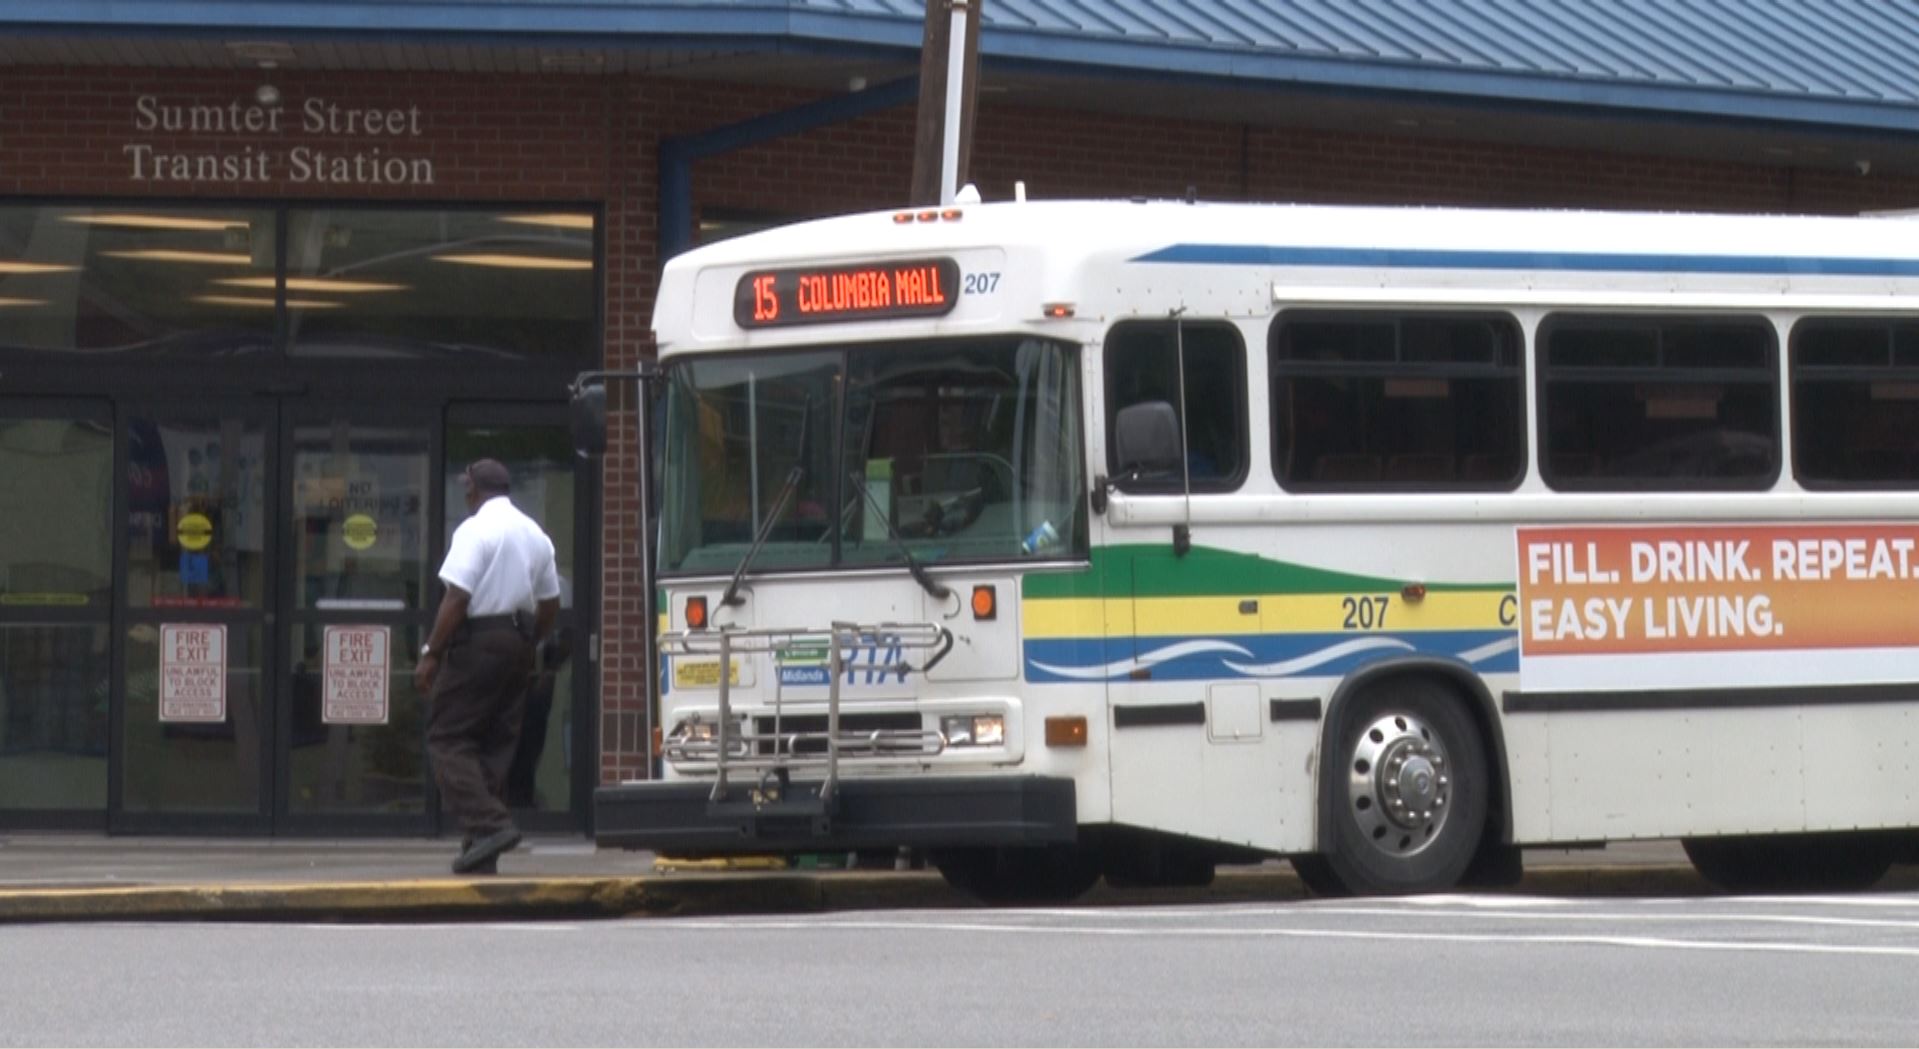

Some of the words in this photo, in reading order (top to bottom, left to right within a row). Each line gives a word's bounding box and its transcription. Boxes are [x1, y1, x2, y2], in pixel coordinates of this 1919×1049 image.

[136, 95, 283, 132] Sumter
[303, 97, 421, 134] Street
[123, 144, 270, 181] Transit
[289, 146, 434, 184] Station
[964, 272, 1001, 295] 207
[752, 276, 778, 321] 15
[798, 271, 890, 313] COLUMBIA
[895, 266, 944, 306] MALL
[1528, 543, 1620, 585] FILL.
[1630, 540, 1761, 583] DRINK.
[1772, 538, 1919, 580] REPEAT.
[1342, 596, 1389, 629] 207
[1530, 597, 1633, 641] EASY
[1643, 594, 1784, 638] LIVING.
[176, 631, 209, 646] FIRE
[340, 633, 373, 648] FIRE
[176, 646, 209, 661] EXIT
[340, 648, 373, 664] EXIT
[166, 667, 219, 678] UNLAWFUL
[329, 668, 383, 680] UNLAWFUL
[782, 668, 824, 681] Midlands
[170, 678, 182, 688] TO
[185, 678, 217, 689] BLOCK
[333, 680, 345, 690] TO
[347, 680, 380, 691] BLOCK
[174, 688, 213, 698] ACCESS
[336, 690, 376, 700] ACCESS
